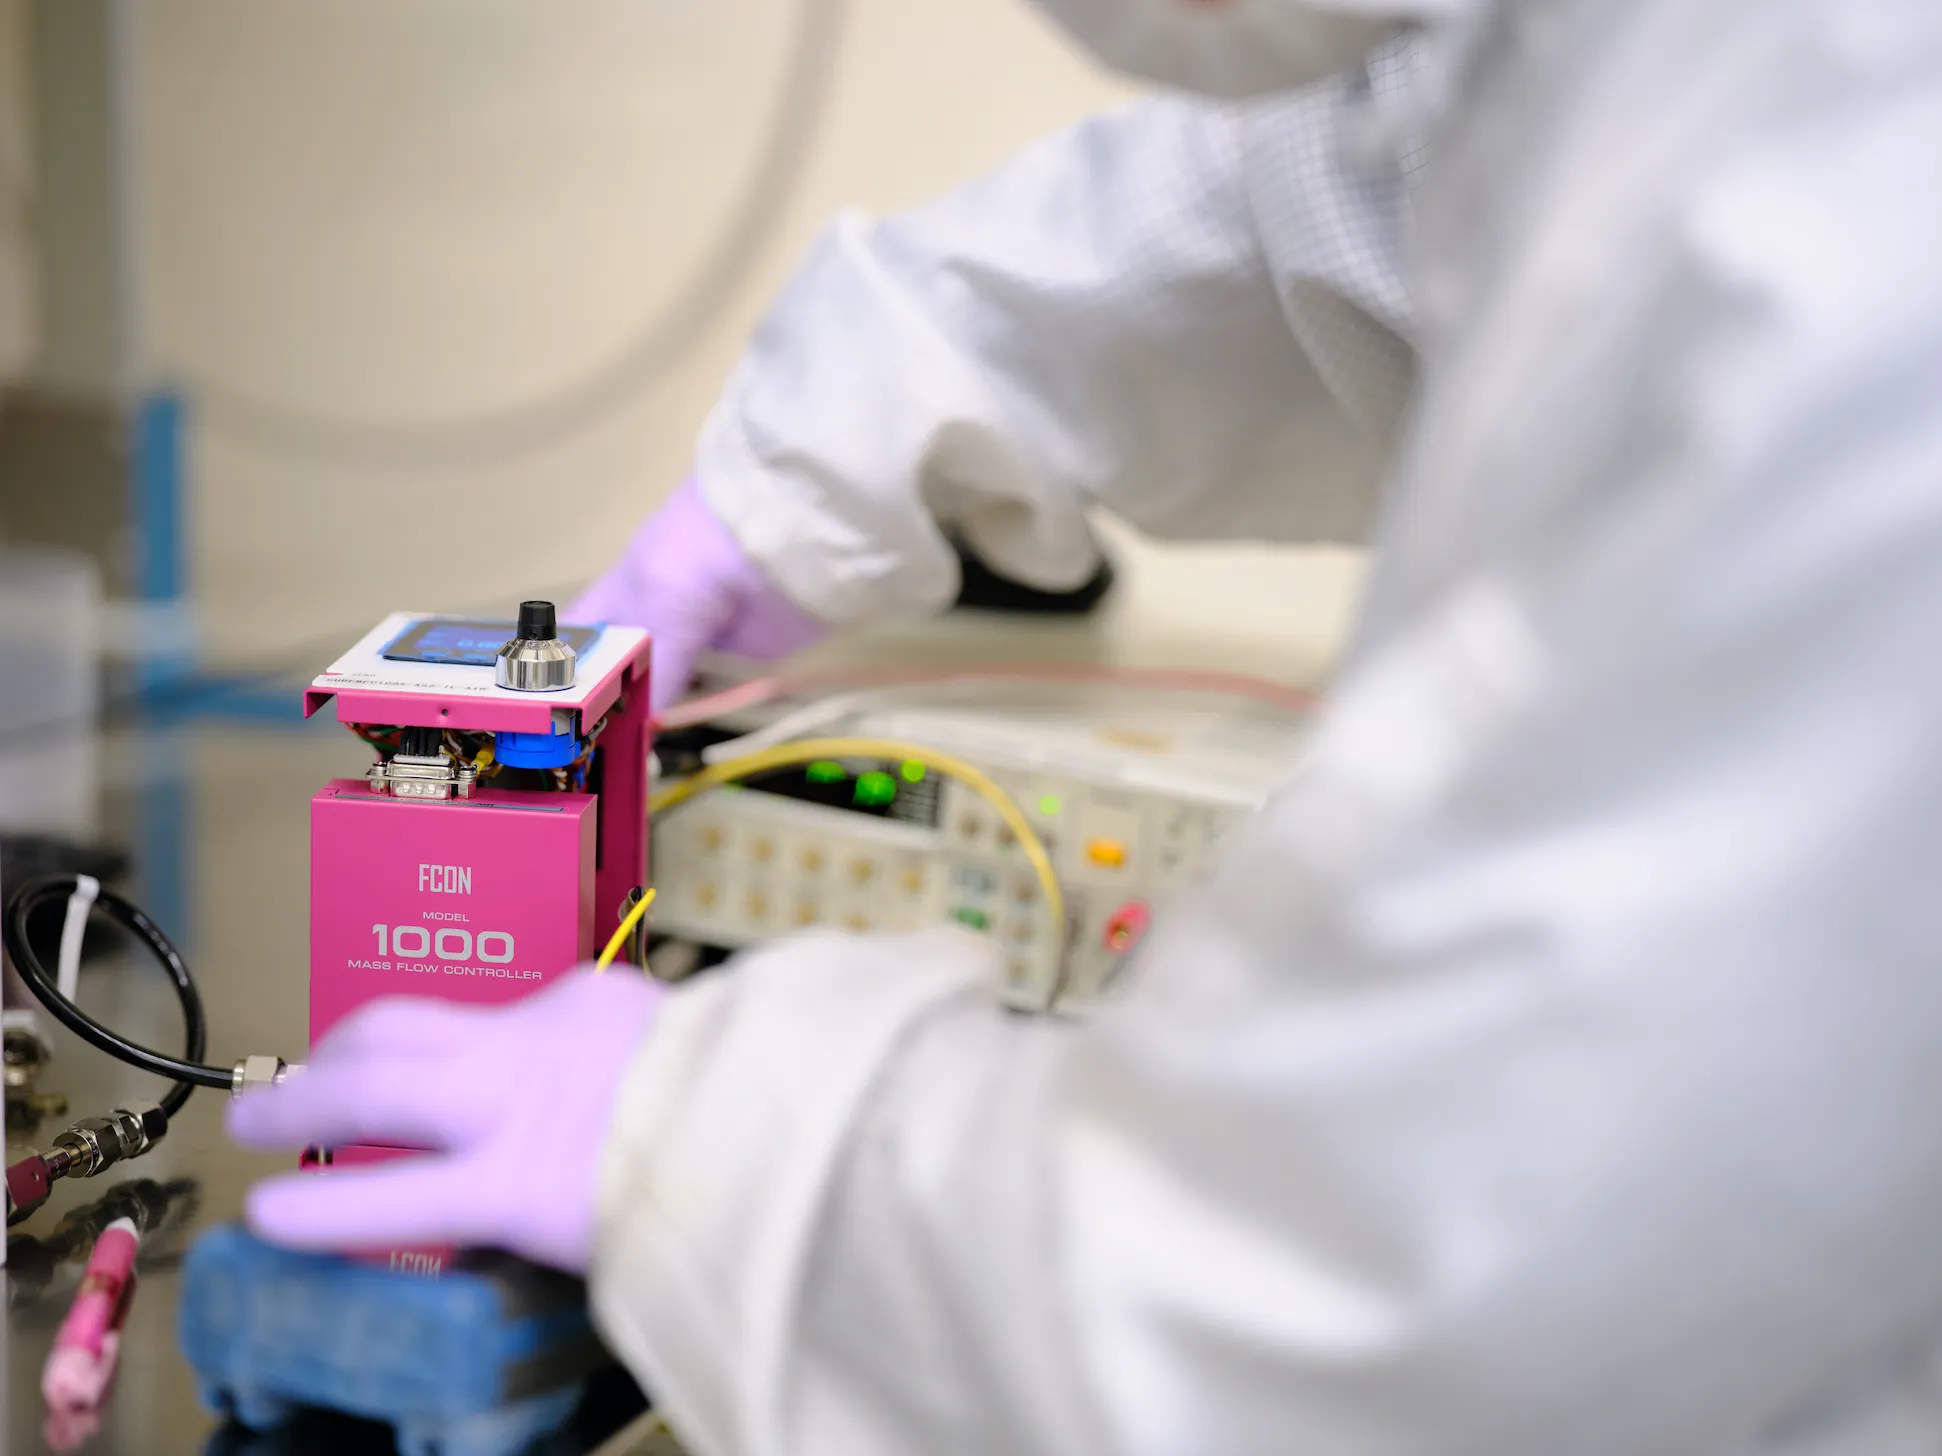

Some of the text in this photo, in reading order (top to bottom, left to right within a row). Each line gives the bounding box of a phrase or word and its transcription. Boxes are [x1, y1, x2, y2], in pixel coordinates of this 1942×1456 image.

[418, 863, 472, 895] FCON
[422, 911, 470, 922] MODEL
[372, 923, 515, 964] 1000
[347, 959, 543, 980] MASS FLOW CONTROLLER
